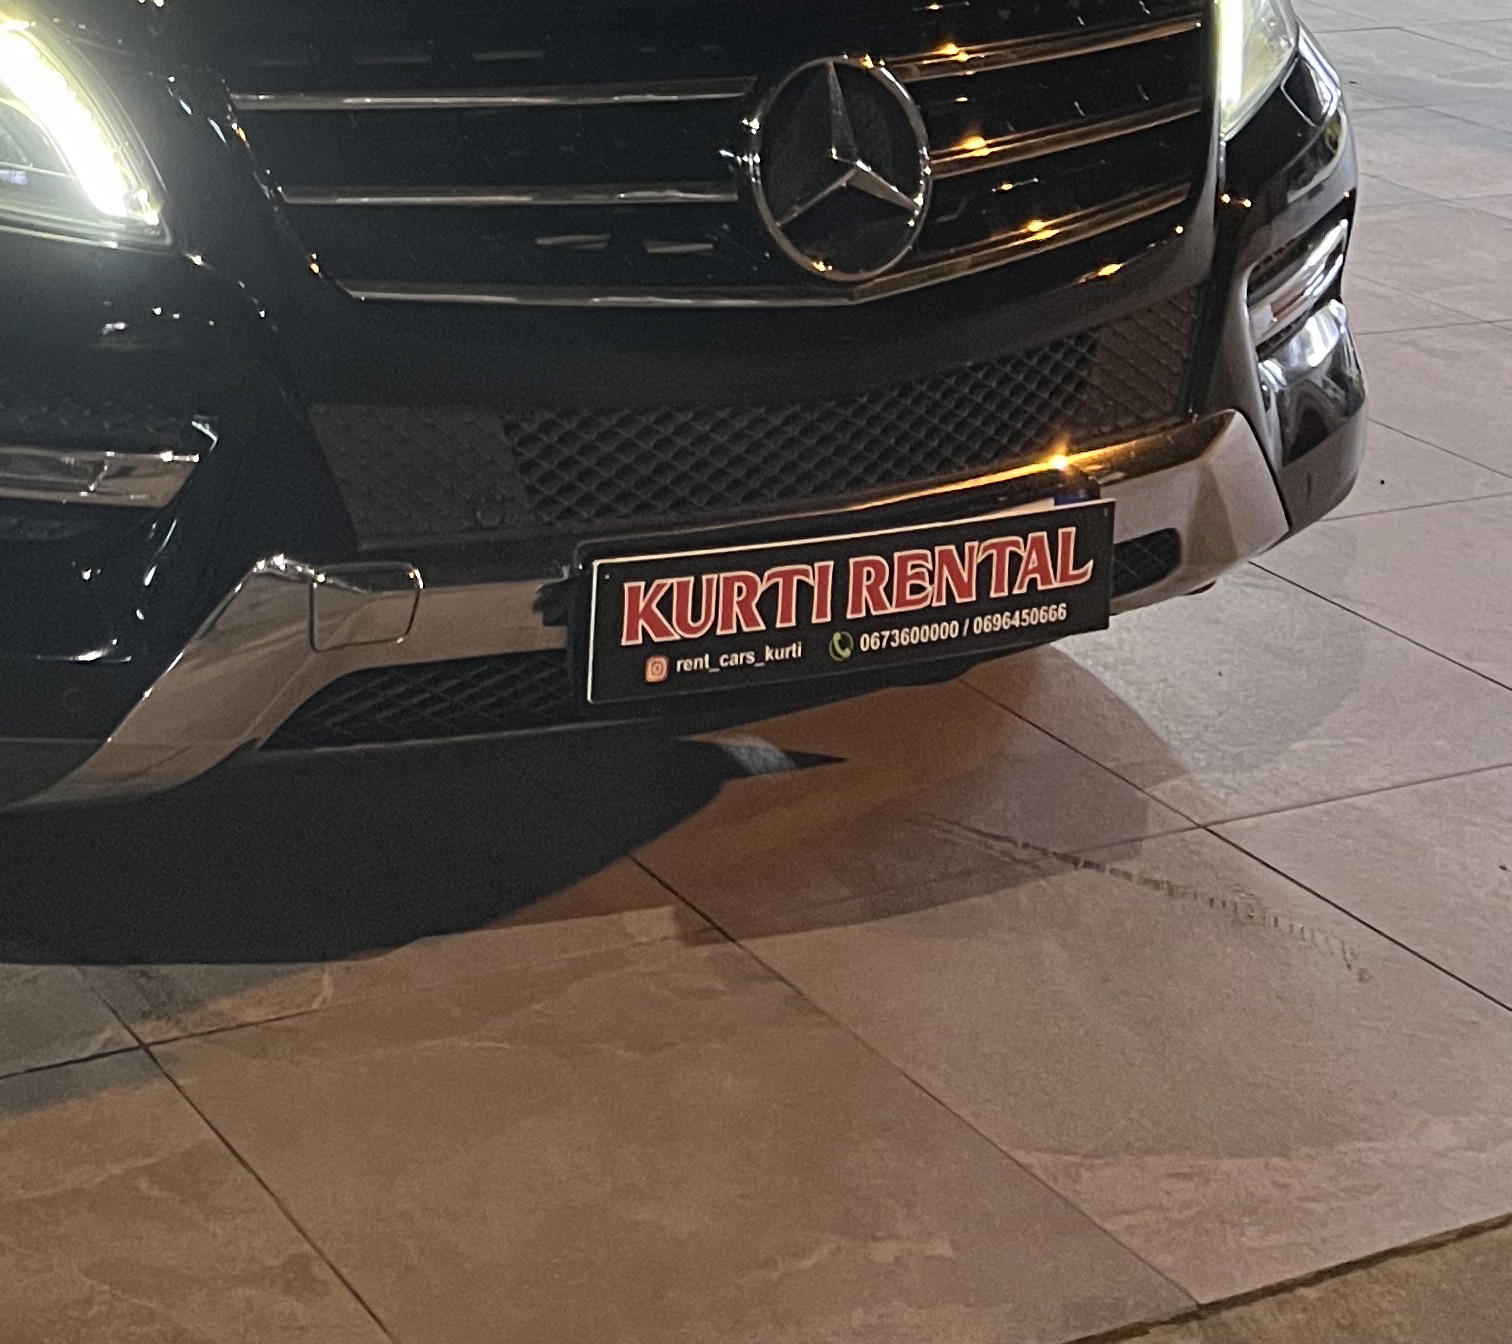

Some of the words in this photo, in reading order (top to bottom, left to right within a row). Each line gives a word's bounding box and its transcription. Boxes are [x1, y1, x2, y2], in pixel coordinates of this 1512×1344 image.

[620, 561, 834, 647] KURTI
[846, 526, 1094, 619] RENTAL
[675, 641, 803, 674] rent_cars_kurti
[859, 620, 960, 654] 0673600000
[972, 603, 1068, 636] 0696450666
